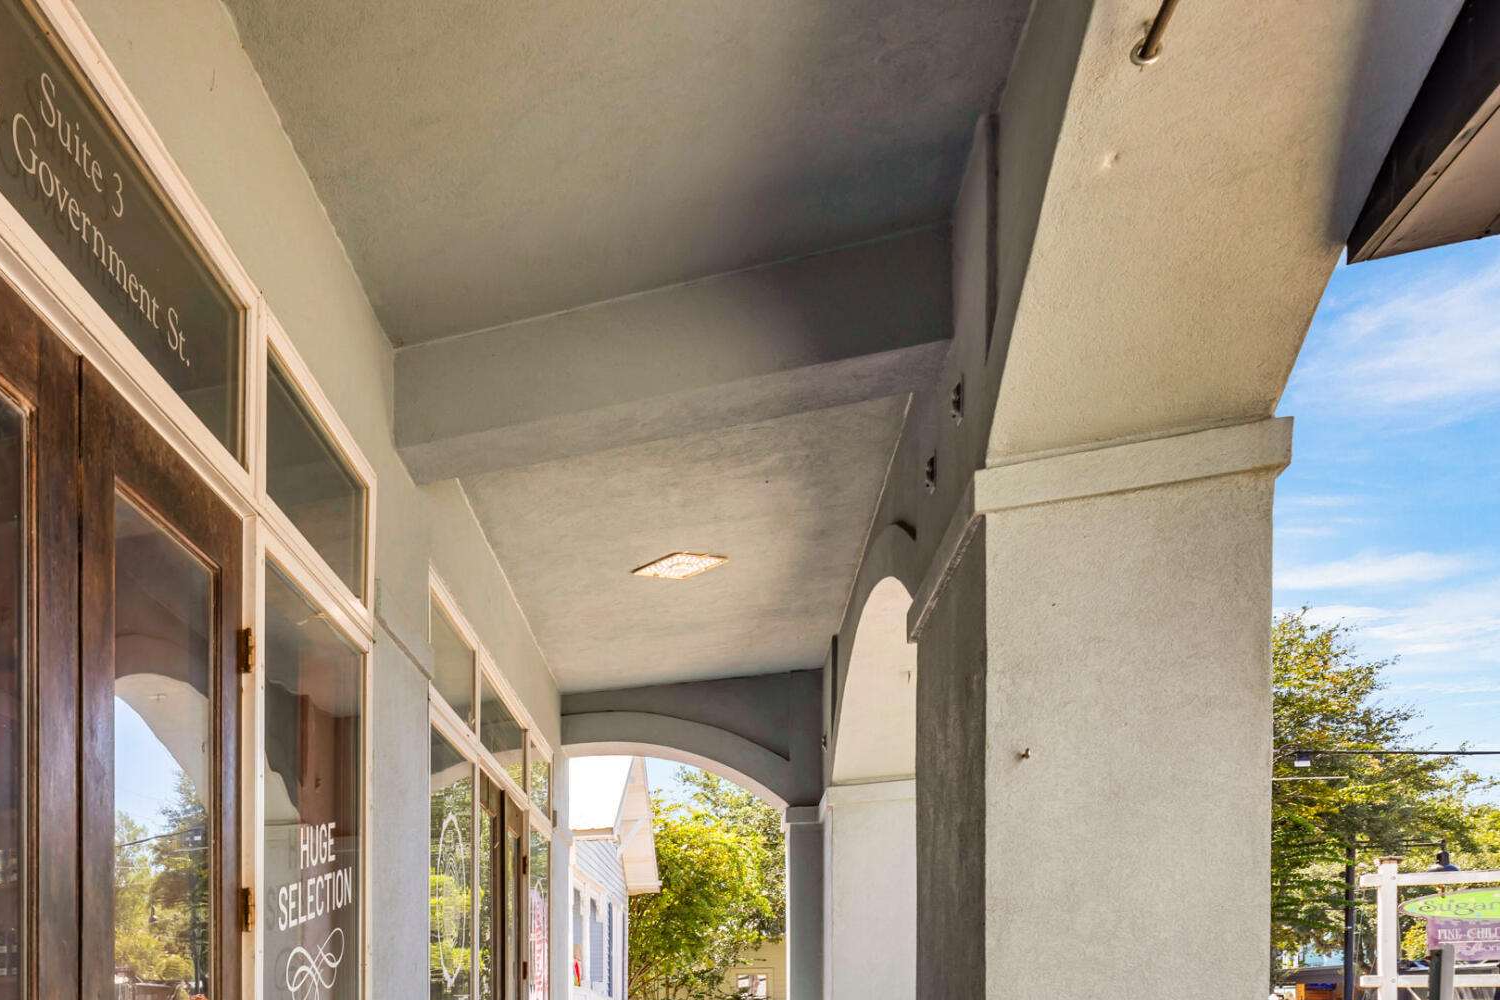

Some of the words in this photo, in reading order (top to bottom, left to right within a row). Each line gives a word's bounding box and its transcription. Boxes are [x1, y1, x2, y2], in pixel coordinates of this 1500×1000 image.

[39, 72, 103, 193] Suite
[112, 171, 124, 218] 3
[12, 112, 160, 330] Government
[167, 307, 191, 368] St.
[278, 866, 352, 931] SELECTION
[300, 822, 336, 870] HUGE
